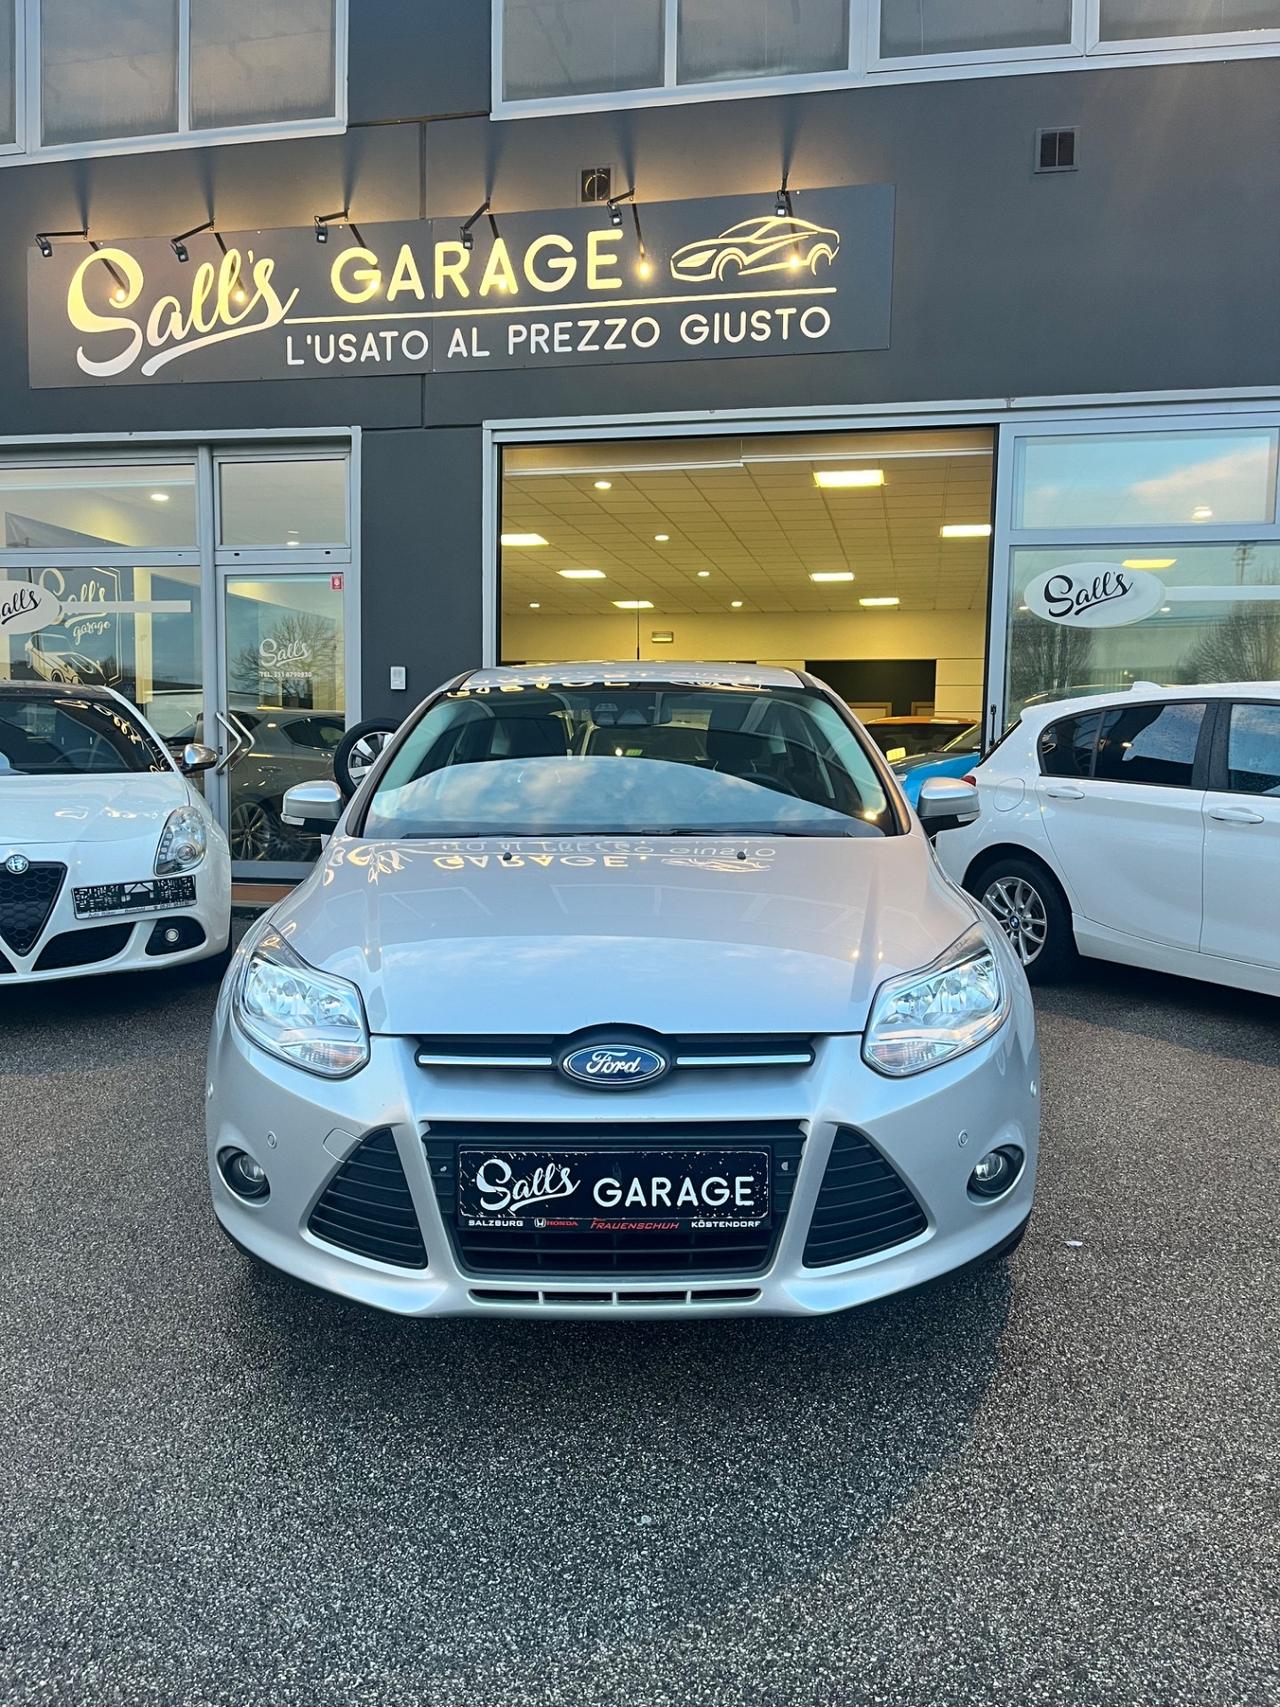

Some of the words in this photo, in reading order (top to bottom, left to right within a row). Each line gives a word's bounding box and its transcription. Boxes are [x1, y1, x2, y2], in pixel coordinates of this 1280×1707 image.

[67, 247, 299, 377] Sall's
[330, 228, 624, 304] GARAGE
[286, 330, 429, 366] L'USATO
[447, 327, 490, 358] AL
[507, 315, 661, 355] PREZZO
[679, 305, 831, 346] GIUSTO
[1043, 570, 1133, 618] Sall's
[73, 620, 111, 646] garage
[586, 1050, 641, 1073] Ford
[476, 1158, 581, 1213] Sall's
[593, 1176, 754, 1208] GARAGE
[468, 1219, 524, 1227] SALZBURG
[590, 1219, 680, 1230] FRAUENSCHUH
[691, 1220, 761, 1229] KÖSTENDORF
